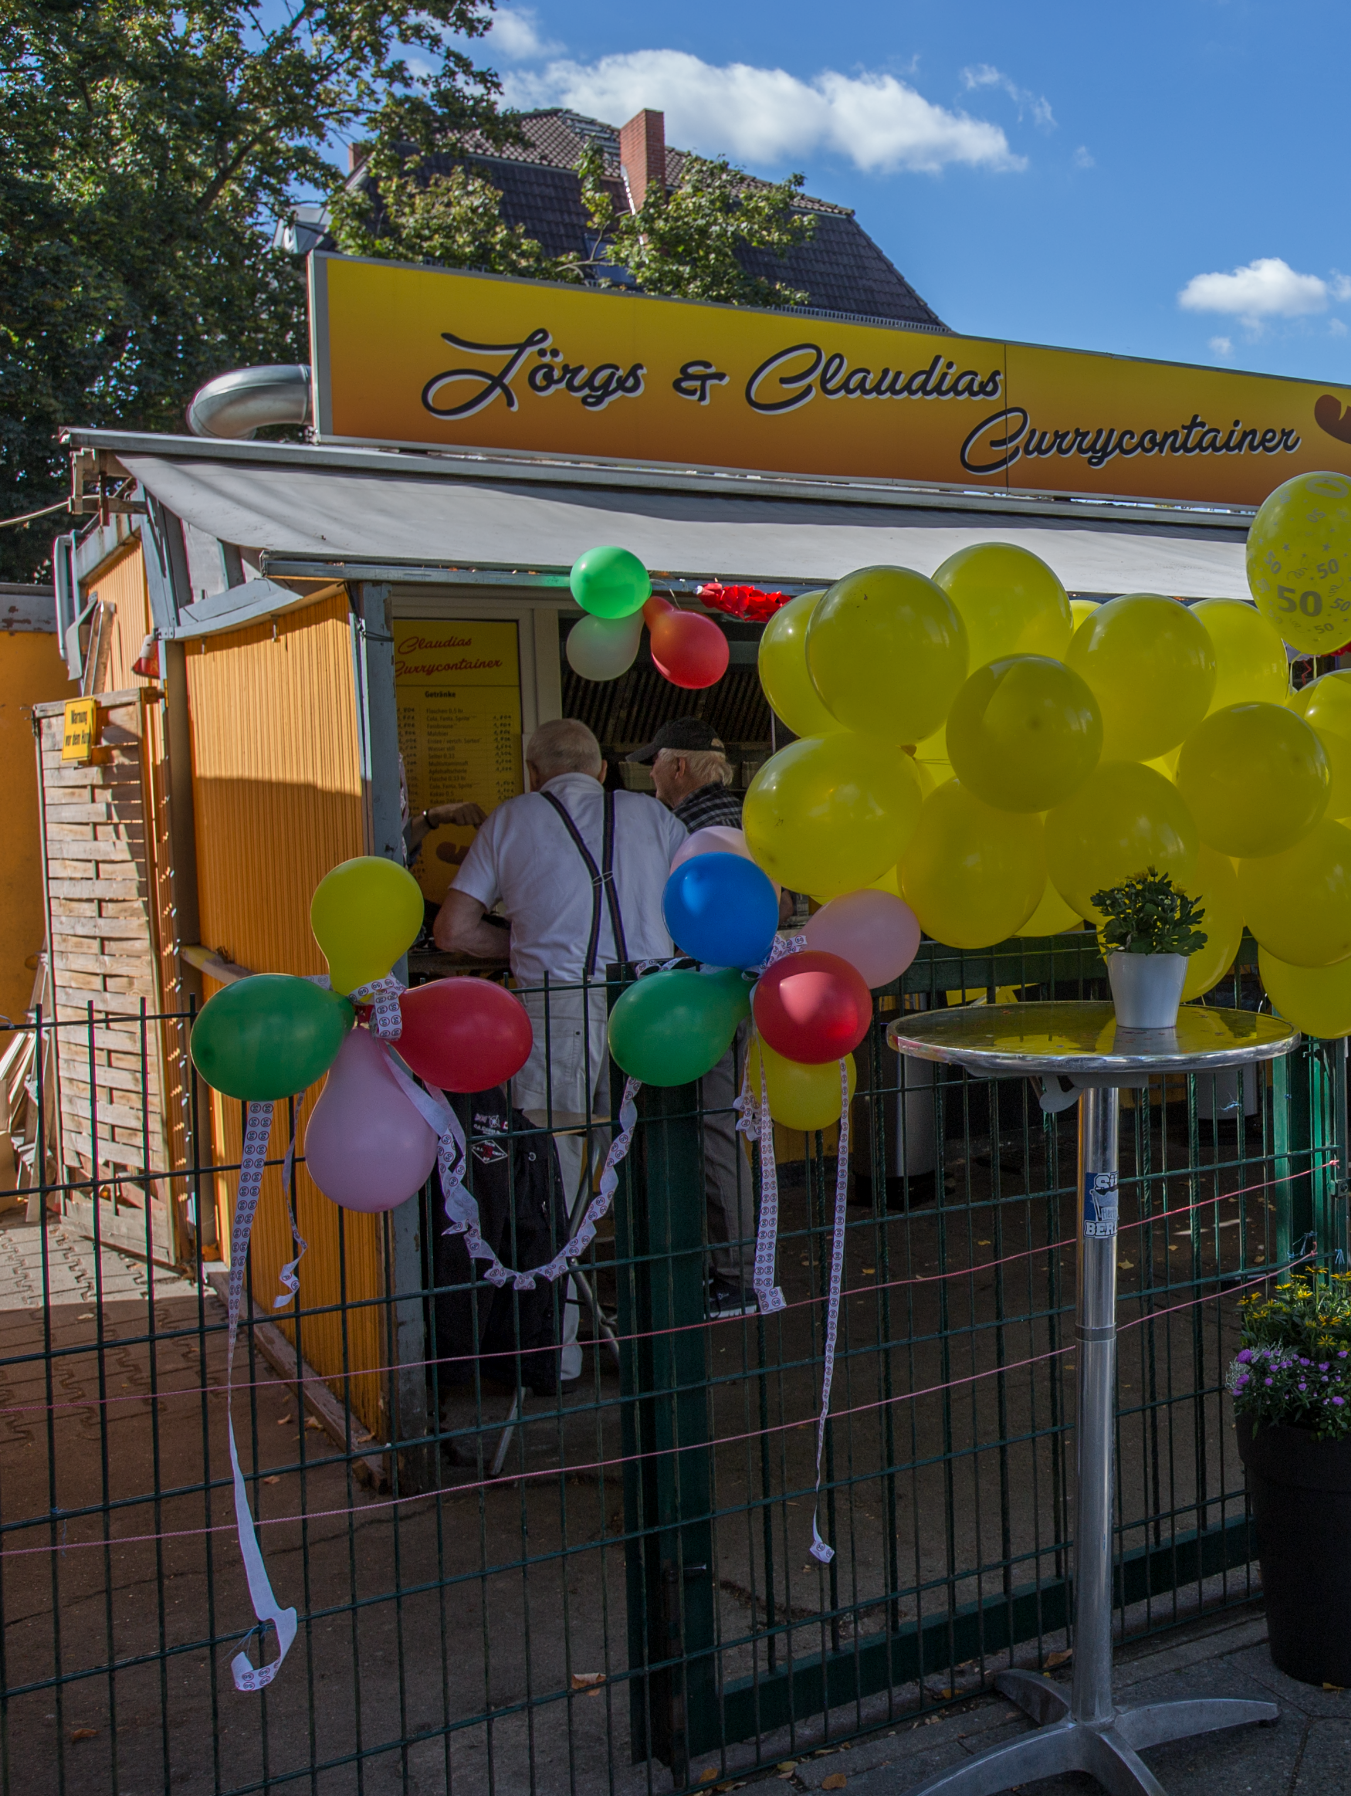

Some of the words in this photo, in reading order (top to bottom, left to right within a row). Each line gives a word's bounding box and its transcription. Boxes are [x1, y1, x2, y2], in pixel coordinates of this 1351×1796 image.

[673, 359, 729, 405] &
[745, 342, 1004, 416] Claudias
[960, 406, 1302, 477] Currycontainer
[1317, 558, 1339, 579] 50
[1277, 585, 1323, 617] 50
[1330, 598, 1351, 612] 50
[1314, 623, 1334, 634] 50
[397, 636, 472, 655] Claudias
[424, 690, 456, 698] Getränke
